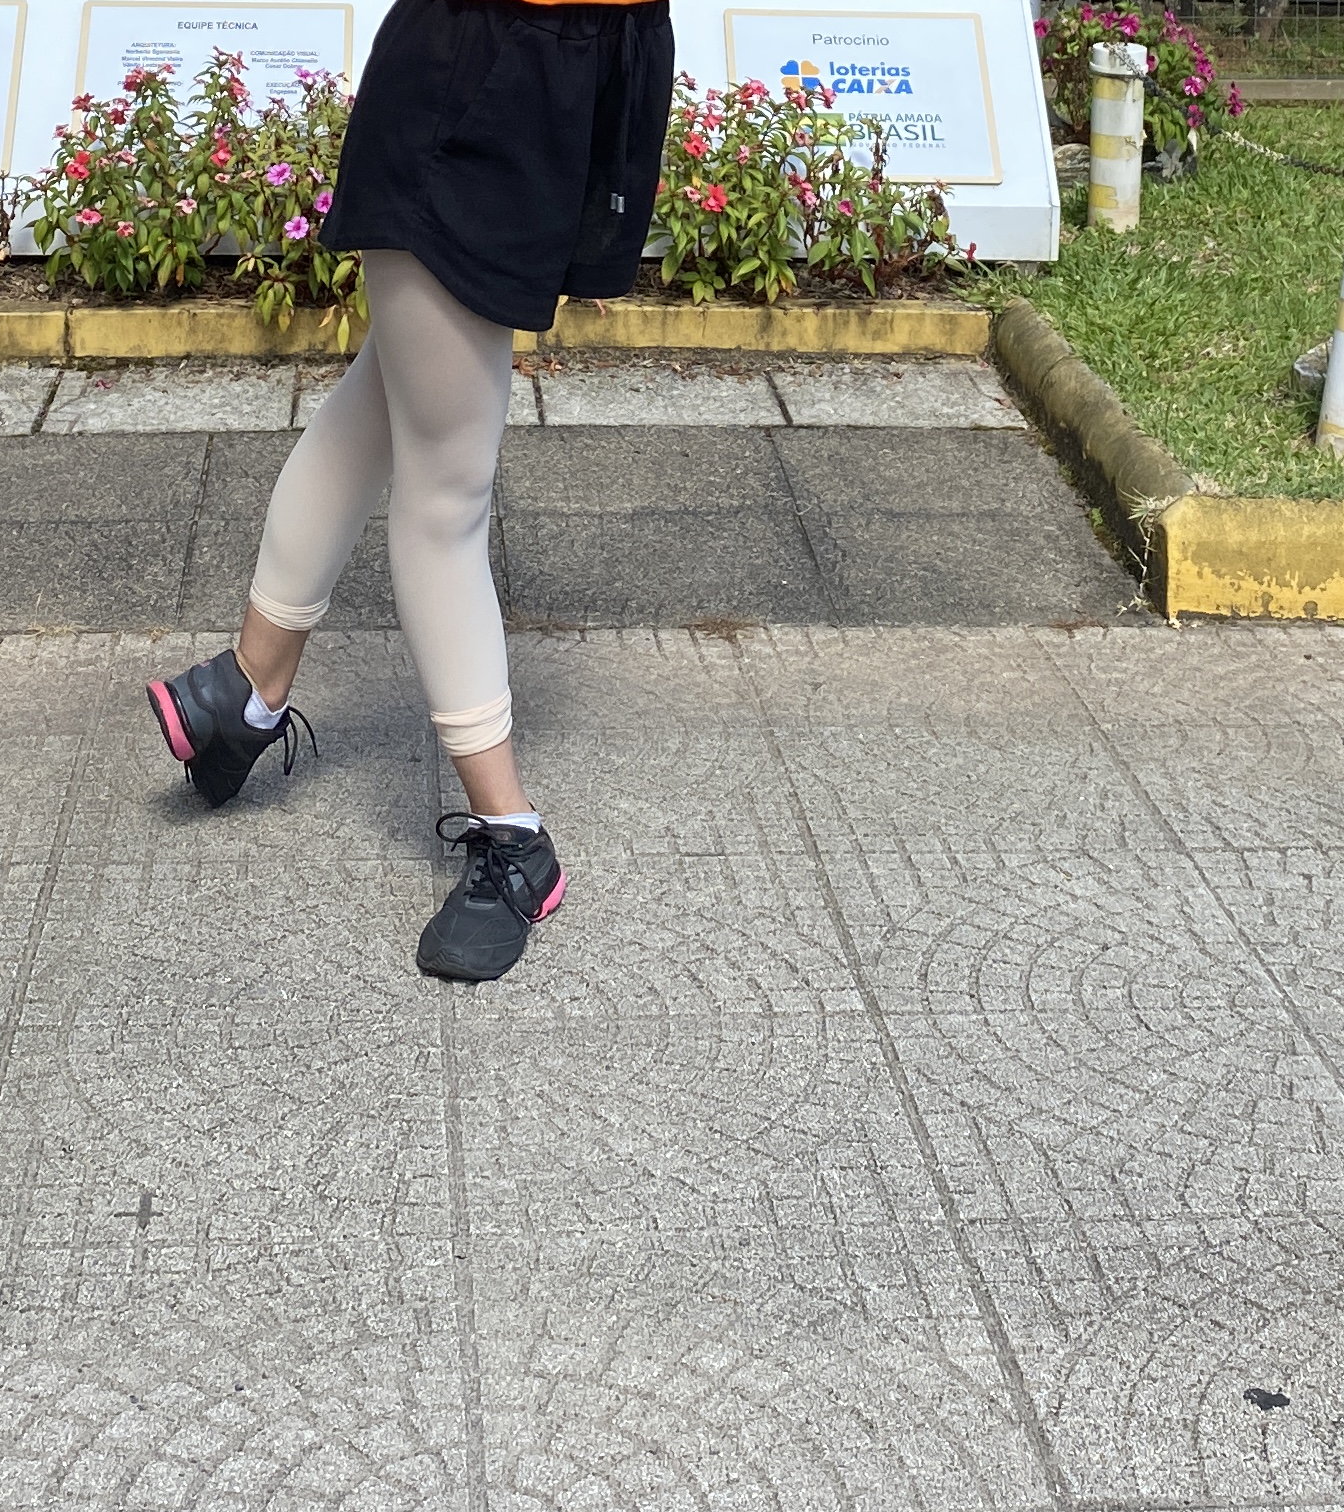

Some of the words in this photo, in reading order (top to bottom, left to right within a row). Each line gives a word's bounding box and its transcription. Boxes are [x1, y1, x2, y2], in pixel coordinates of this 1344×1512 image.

[177, 21, 214, 30] EQUIPE
[216, 20, 259, 30] TÉCNICA
[812, 33, 890, 47] Patrocínio
[829, 61, 911, 77] loterias
[832, 77, 914, 94] CAIXA
[895, 113, 943, 123] AMADA
